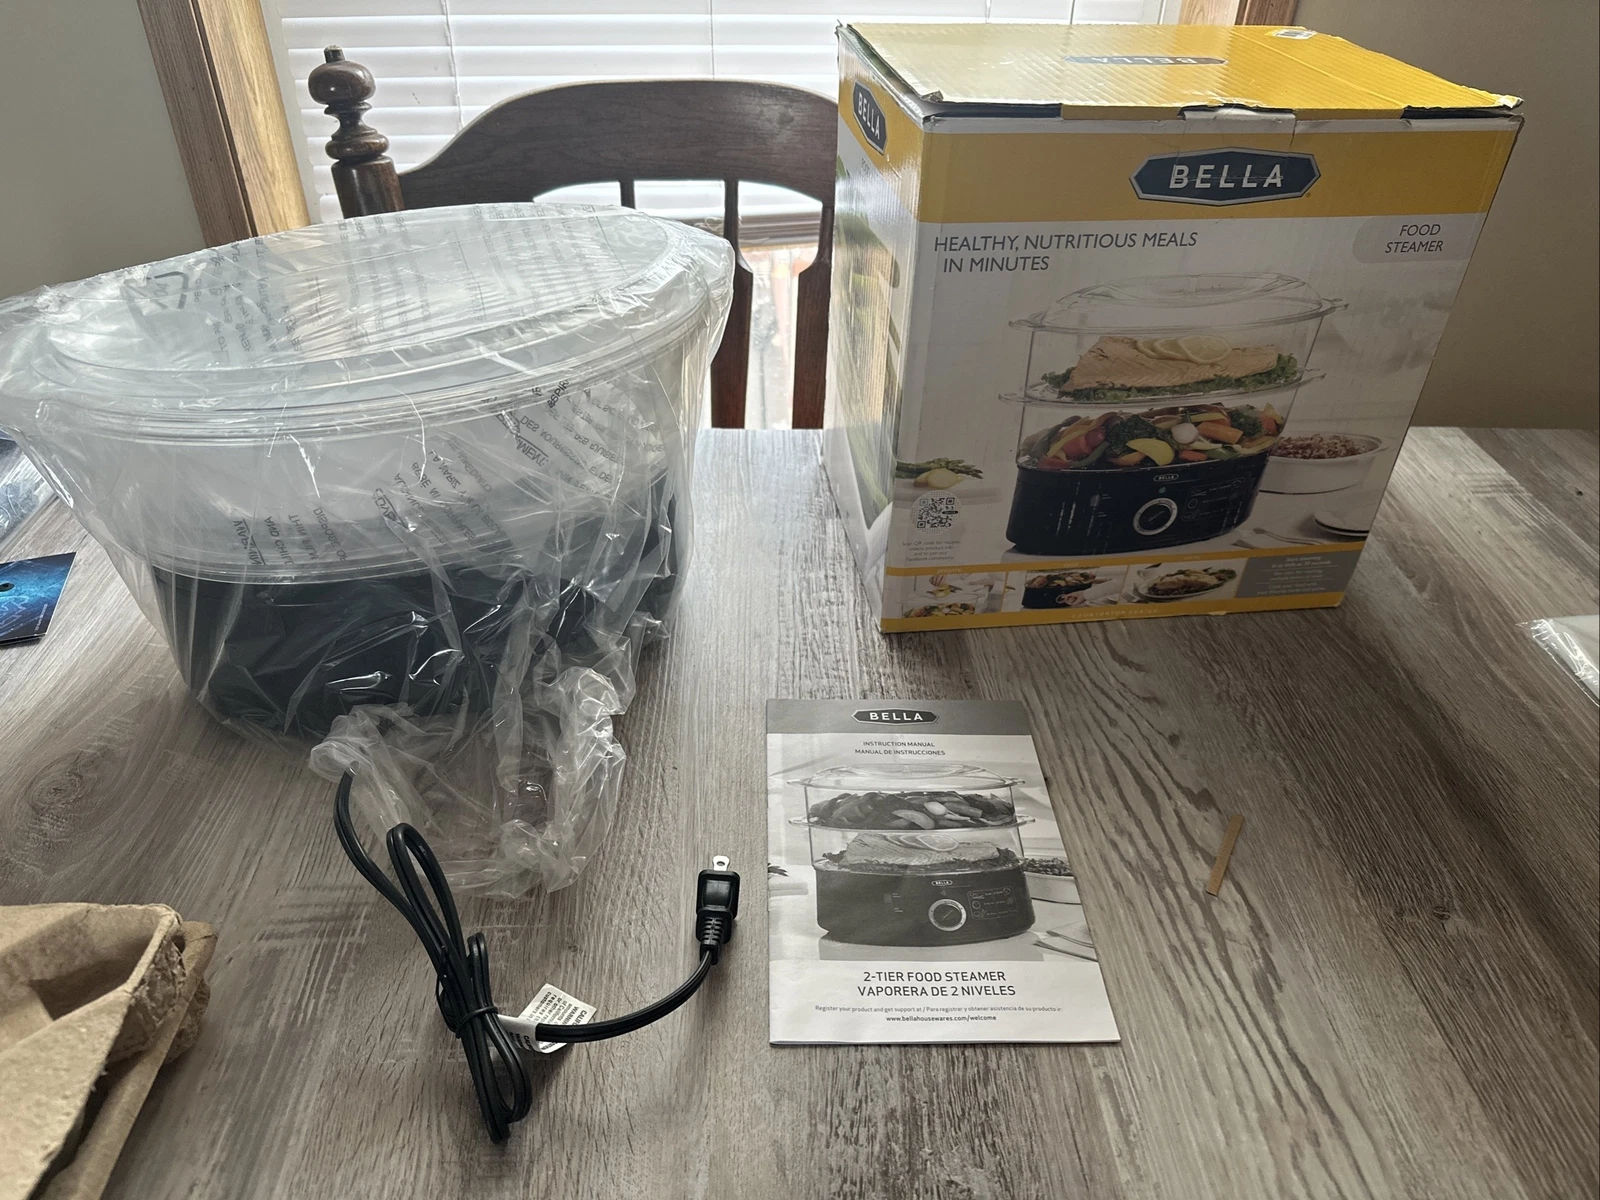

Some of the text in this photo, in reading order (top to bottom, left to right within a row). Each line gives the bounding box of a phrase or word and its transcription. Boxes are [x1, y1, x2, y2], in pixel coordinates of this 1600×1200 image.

[1091, 57, 1199, 65] BELLA
[857, 91, 880, 140] BELLA
[1168, 164, 1284, 189] BELLA
[1399, 223, 1441, 237] FOOD
[934, 232, 1198, 252] HEALTHY, NUTRITIOUS MEALS
[1384, 240, 1444, 254] STEAMER
[943, 256, 1050, 273] IN MINUTES
[869, 712, 924, 721] BELLA
[863, 971, 1006, 982] 2-TIER FOOD STEAMER
[857, 985, 1016, 997] VAPORERA DE 2 NIVELES
[532, 991, 552, 1015] customers
[538, 994, 557, 1016] requires
[547, 1002, 559, 1016] other
[815, 1005, 838, 1013] Register
[851, 1005, 873, 1013] product
[562, 1006, 580, 1026] WARNIN
[571, 1009, 588, 1026] CALIFO
[886, 1014, 997, 1022] www.bellahousewares.com/welcome
